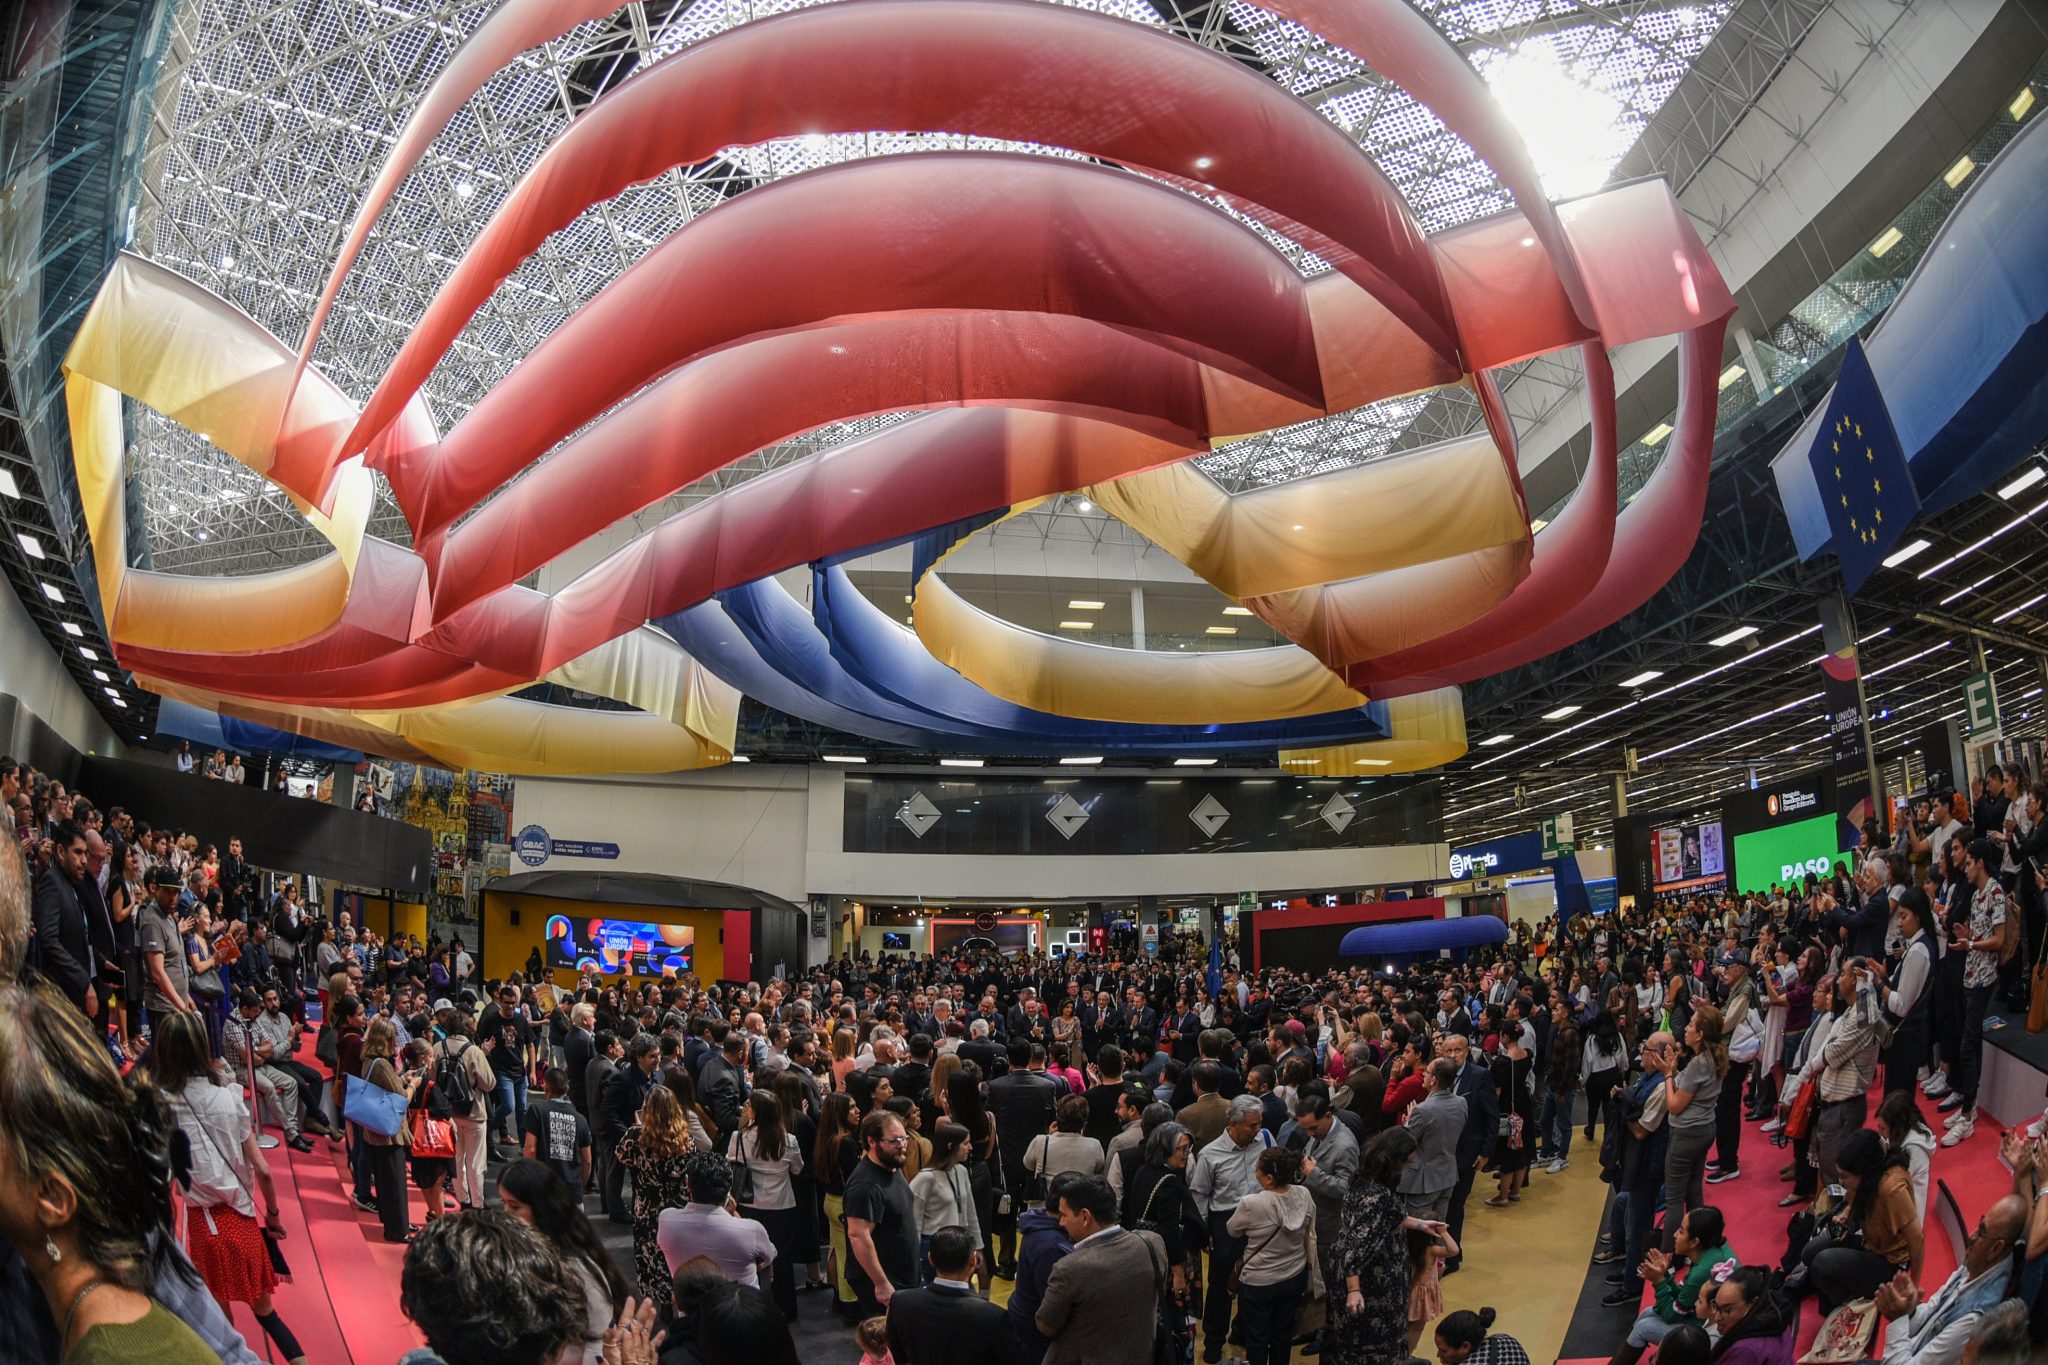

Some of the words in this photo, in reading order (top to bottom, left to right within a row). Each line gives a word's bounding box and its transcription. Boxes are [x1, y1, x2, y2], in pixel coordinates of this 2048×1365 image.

[1967, 679, 1993, 730] E
[1835, 707, 1857, 723] UNIÓN
[1831, 715, 1863, 734] EUROPEA
[1782, 790, 1800, 800] Penguin
[1800, 793, 1814, 801] House
[1796, 798, 1816, 808] Editorial
[1542, 819, 1553, 849] F
[523, 841, 544, 850] GBAC
[1781, 856, 1830, 881] PASO
[604, 942, 633, 951] EUROPEA
[609, 937, 629, 945] UNIÓN
[549, 1111, 575, 1122] STAND
[550, 1121, 576, 1133] DESIGN
